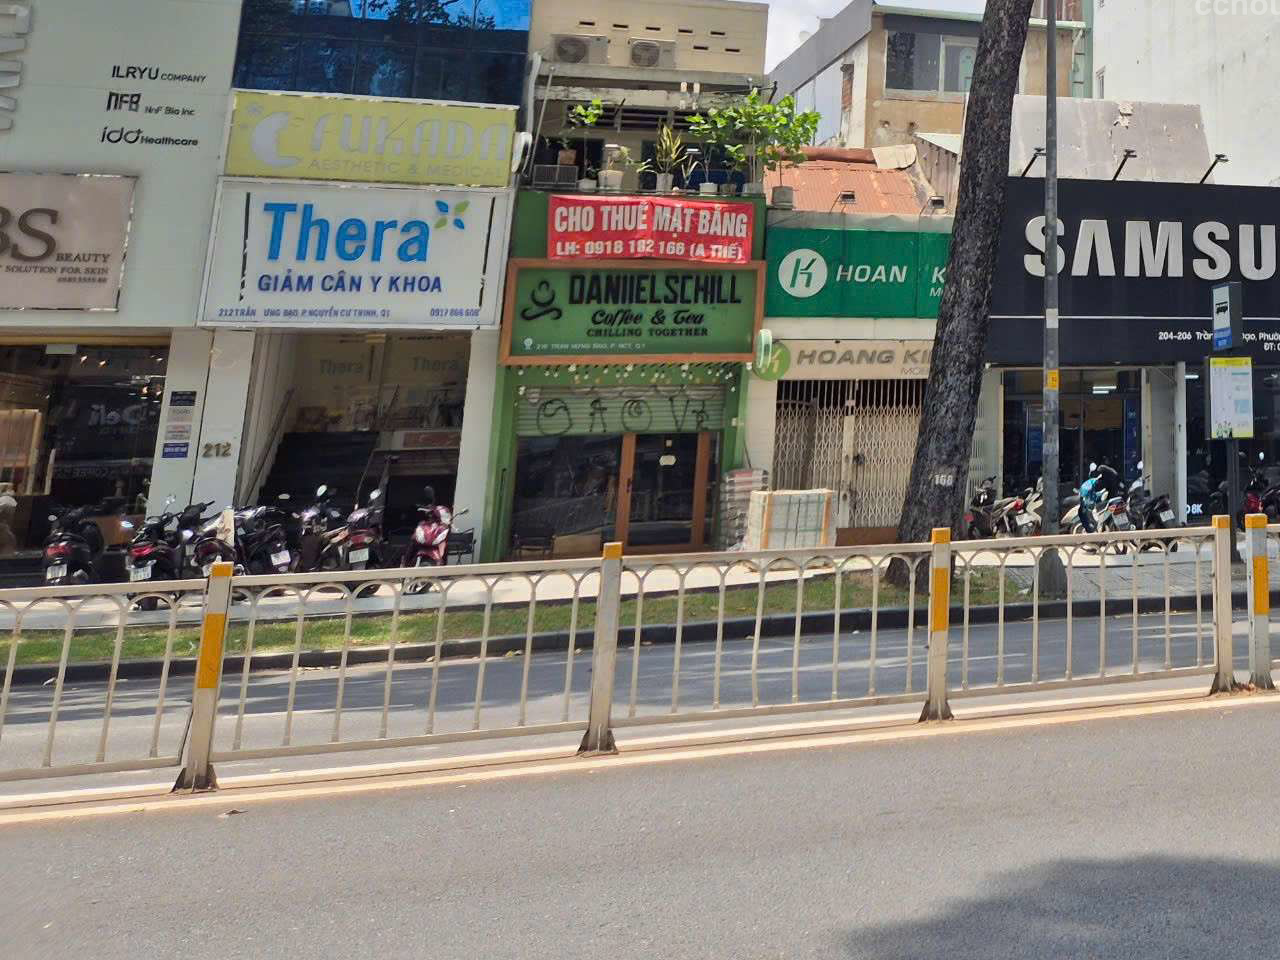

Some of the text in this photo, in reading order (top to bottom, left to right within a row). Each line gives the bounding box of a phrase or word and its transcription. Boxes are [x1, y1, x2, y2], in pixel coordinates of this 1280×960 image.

[112, 65, 207, 83] ILRYU COMPANY
[141, 136, 199, 146] Healthcare
[309, 159, 400, 173] AESTHETIC
[555, 206, 595, 232] CHO
[653, 203, 694, 238] MẶT
[263, 202, 430, 263] Thera
[556, 242, 580, 256] LH:
[690, 243, 705, 257] (A
[56, 253, 110, 263] BEAUTY
[5, 265, 109, 275] SOLUTION FOR SKIN
[836, 265, 908, 283] HOAN
[258, 268, 442, 293] GIẢM CÂN Y KHOA
[218, 308, 233, 317] 212
[591, 309, 705, 326] Coffee & Tea
[587, 328, 708, 337] CHILLING TOGETHER
[1158, 332, 1192, 341] 204-206
[1264, 342, 1276, 351] ĐT:
[797, 349, 931, 365] HOANG KI
[901, 367, 930, 376] MO
[202, 442, 231, 458] 212
